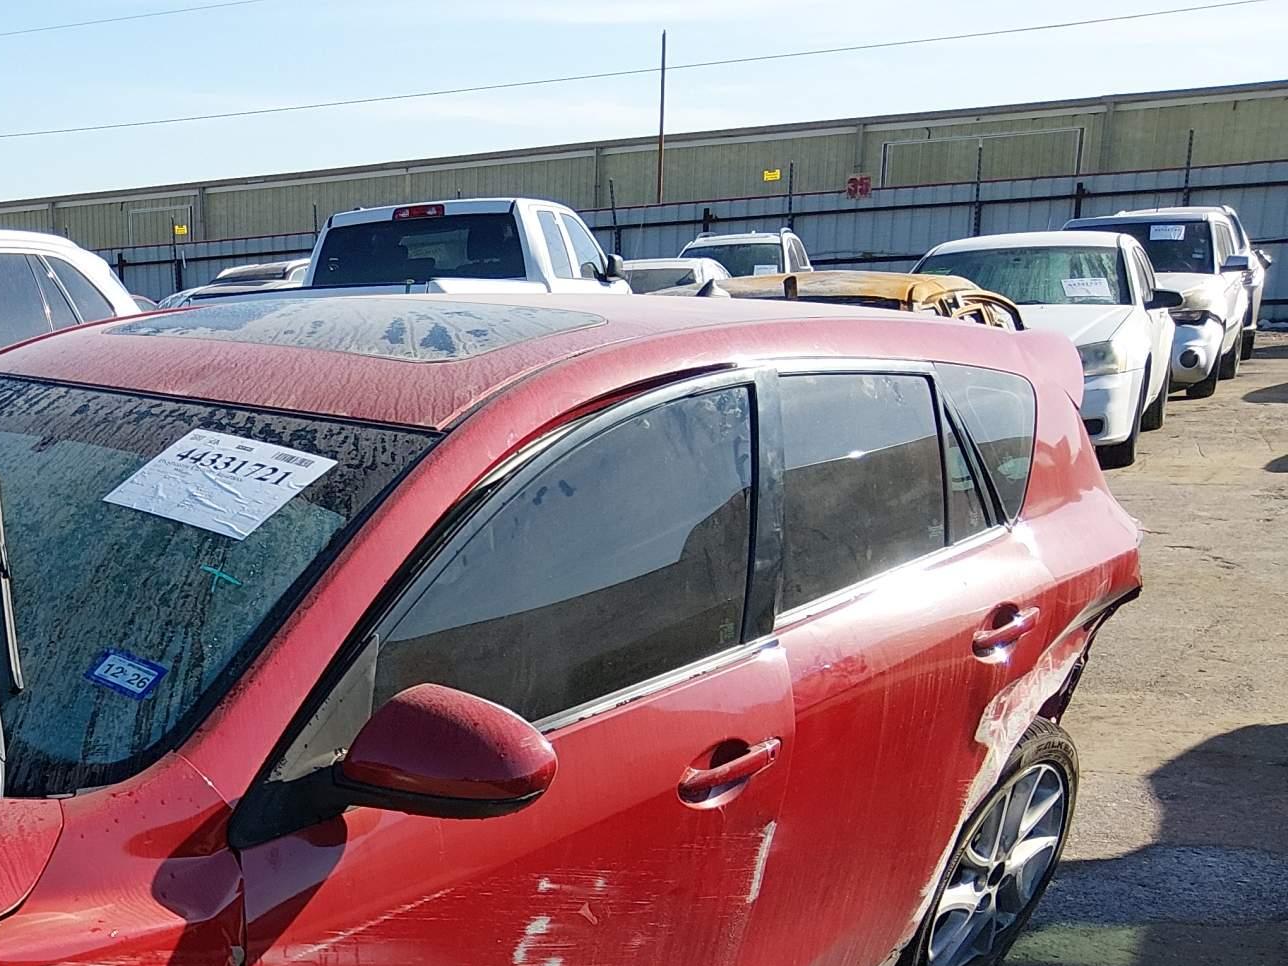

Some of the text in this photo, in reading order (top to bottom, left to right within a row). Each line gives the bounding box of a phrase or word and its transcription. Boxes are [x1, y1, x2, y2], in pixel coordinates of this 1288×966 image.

[176, 448, 292, 485] 44331721
[103, 663, 125, 679] 12
[126, 672, 151, 689] 26
